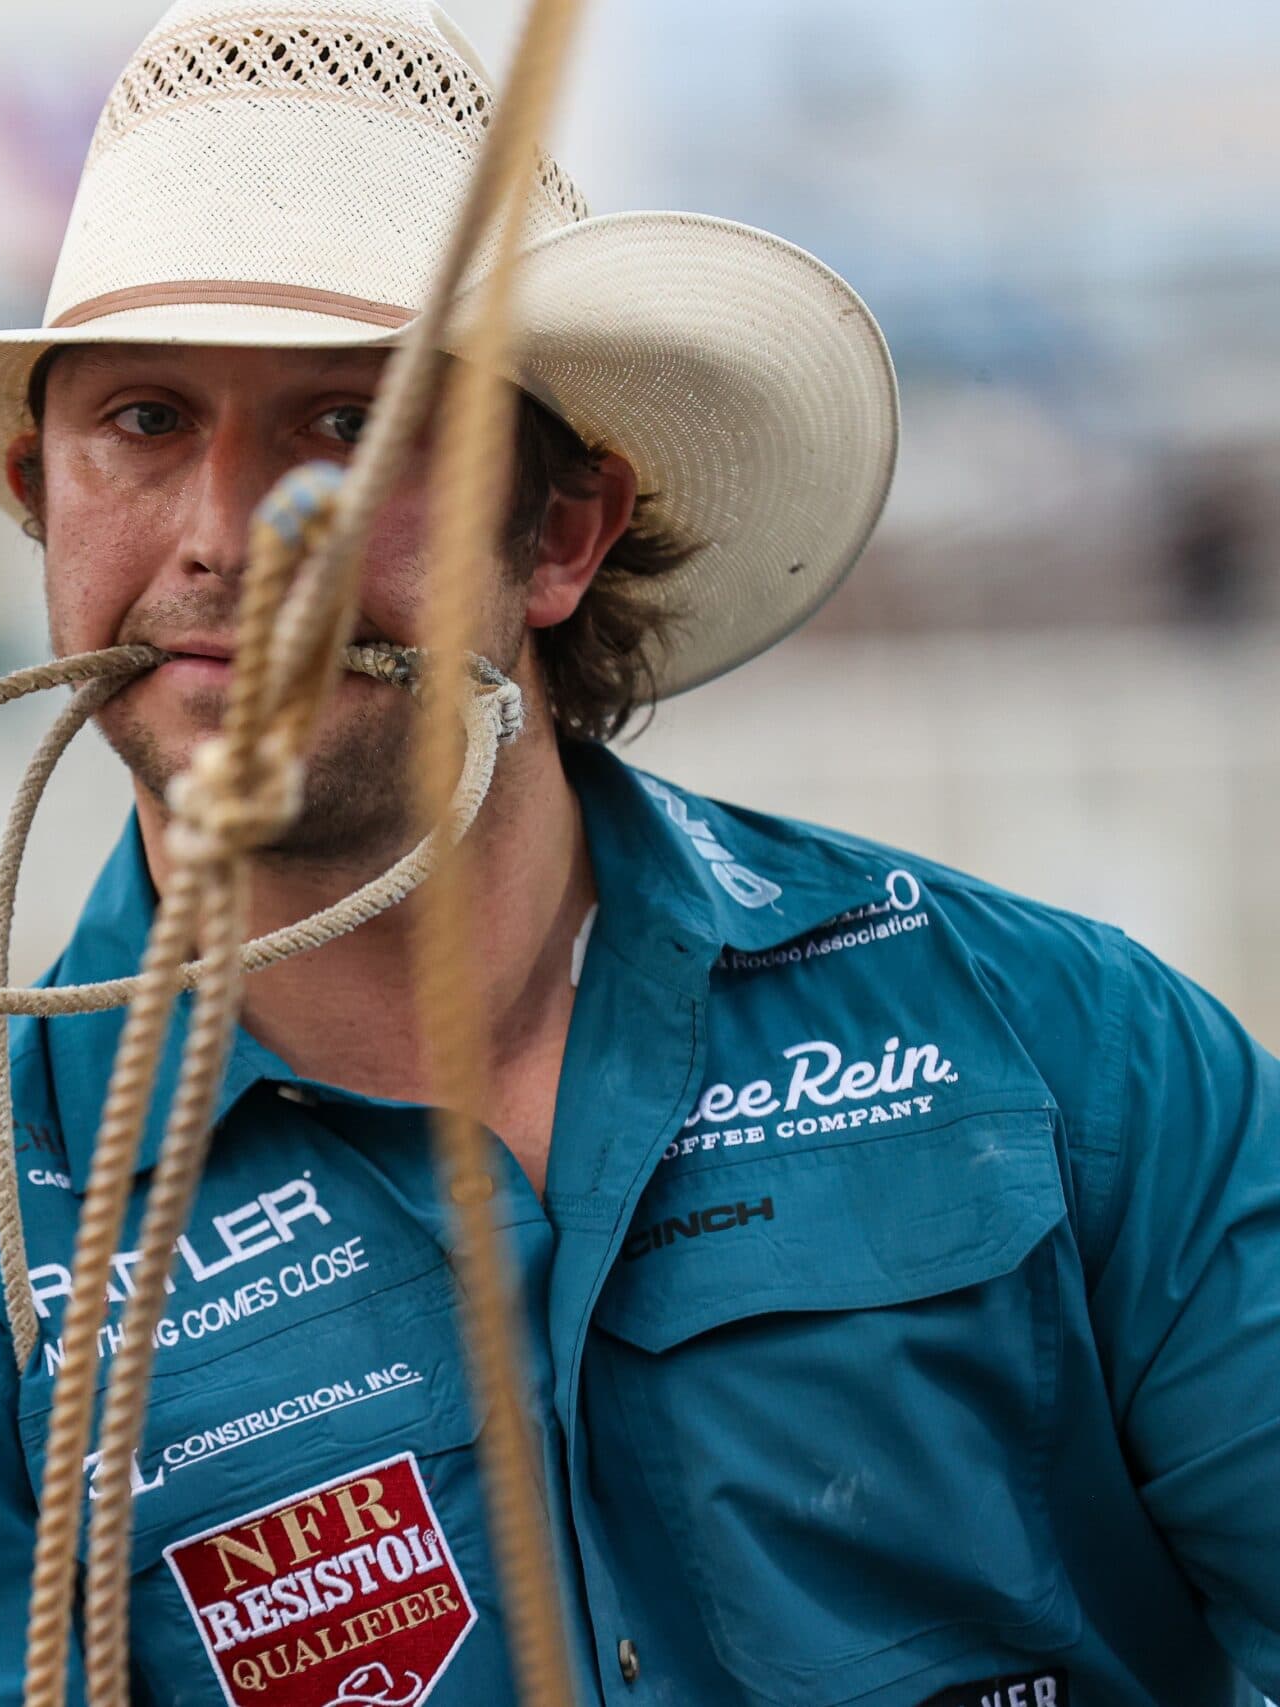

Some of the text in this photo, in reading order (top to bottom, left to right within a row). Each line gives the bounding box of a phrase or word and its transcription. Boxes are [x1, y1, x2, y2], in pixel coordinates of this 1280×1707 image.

[806, 911, 929, 960] Association
[684, 1036, 951, 1128] ee Rein
[776, 1095, 933, 1138] COMPANY
[26, 1178, 332, 1319] RTLER
[622, 1196, 775, 1263] CINCH
[43, 1236, 369, 1376] NTHG COMES CLOSE
[164, 1380, 364, 1465] CONSTRUCTION,
[365, 1363, 419, 1391] INC.
[200, 1524, 444, 1653] RESISTOL
[204, 1478, 401, 1594] NFR
[232, 1583, 460, 1692] QUALIFIER
